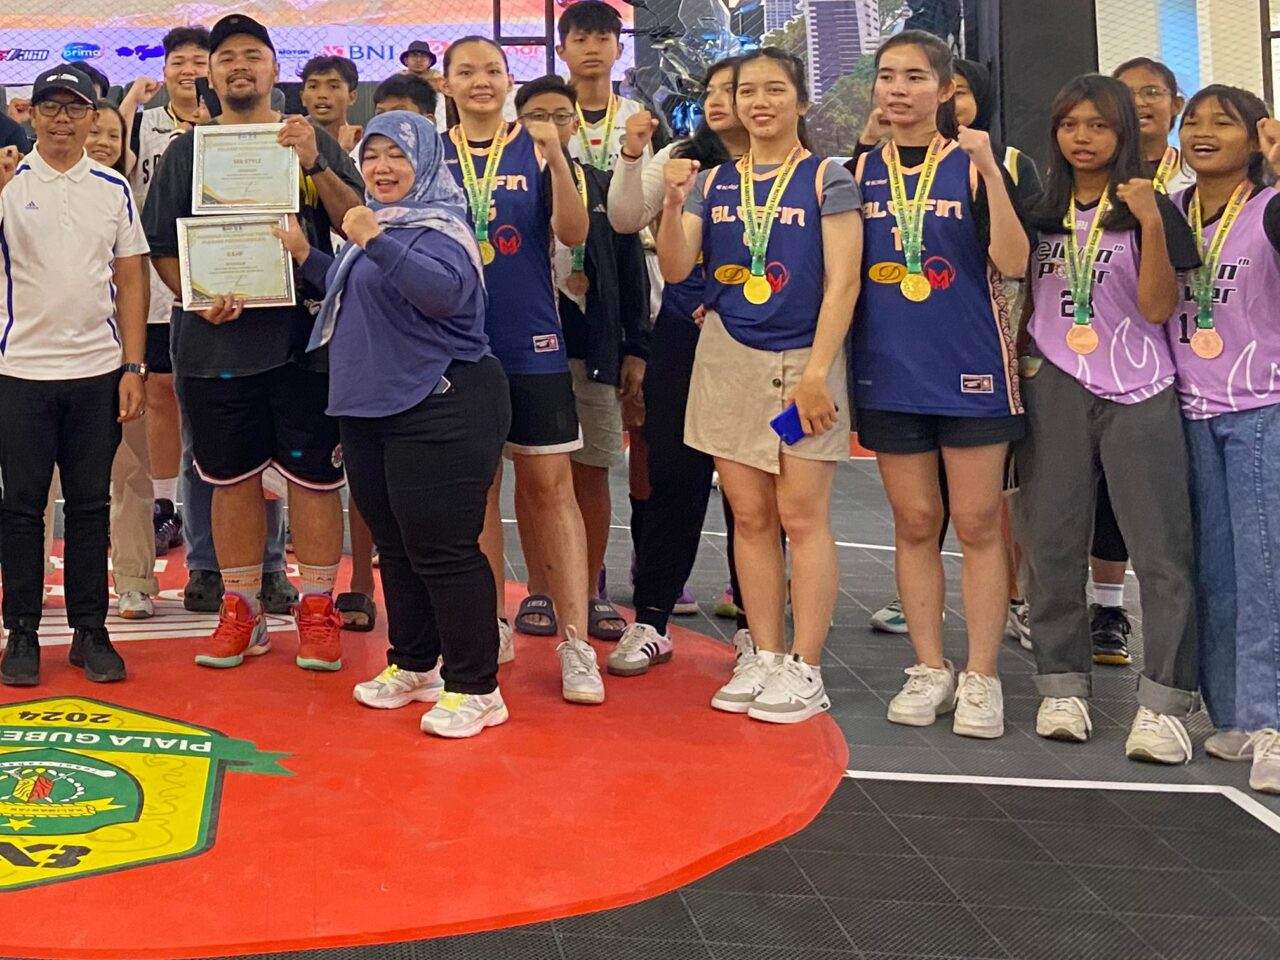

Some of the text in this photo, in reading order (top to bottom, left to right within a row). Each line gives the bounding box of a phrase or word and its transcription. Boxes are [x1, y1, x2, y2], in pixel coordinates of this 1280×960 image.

[63, 49, 102, 59] prima
[350, 45, 395, 60] BNI
[18, 710, 113, 725] 2024
[109, 735, 212, 754] PIALA
